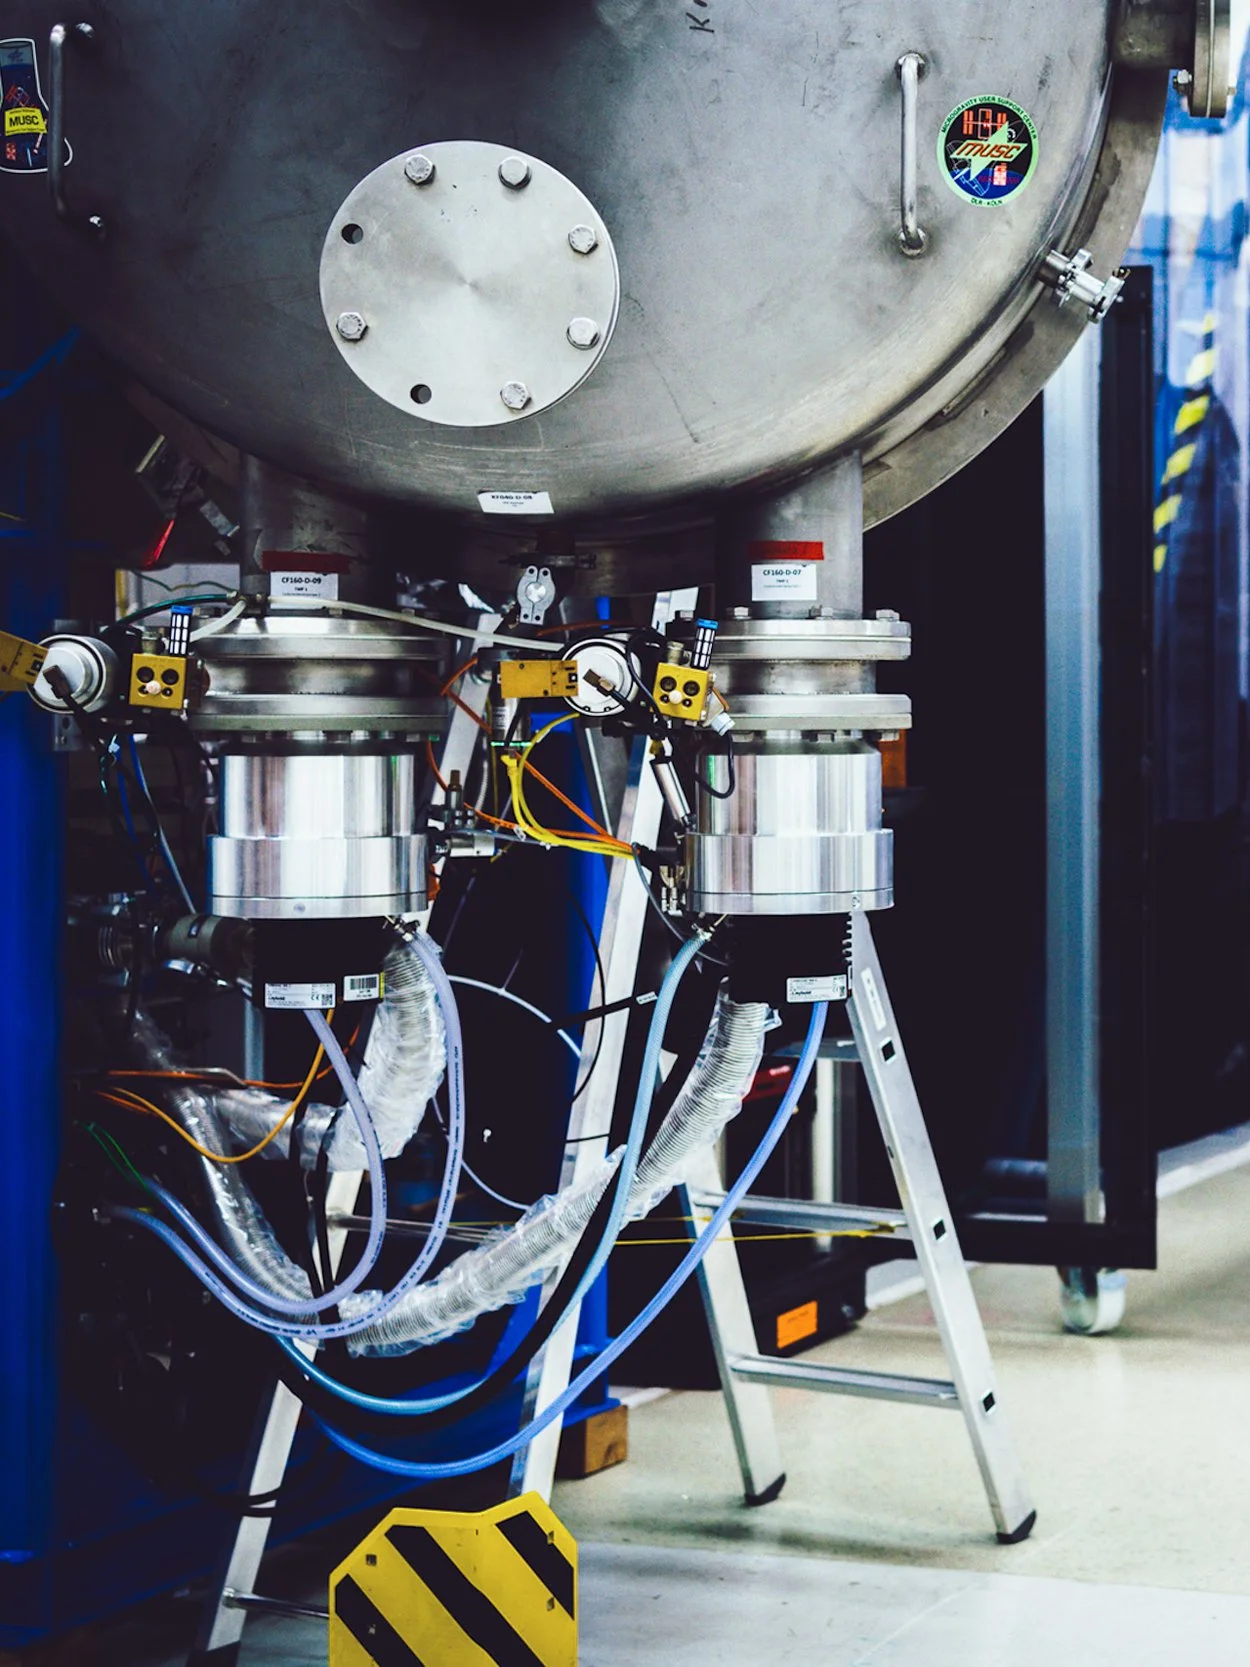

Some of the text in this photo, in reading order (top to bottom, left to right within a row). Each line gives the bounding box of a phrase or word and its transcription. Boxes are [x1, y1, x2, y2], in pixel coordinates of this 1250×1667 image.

[9, 115, 39, 127] MUSC
[941, 98, 977, 133] MICROGRAVITY
[997, 97, 1024, 115] SUPPORT
[1023, 114, 1037, 139] CENTER
[957, 142, 1020, 160] MUSC
[281, 576, 322, 584] CF160-D-09
